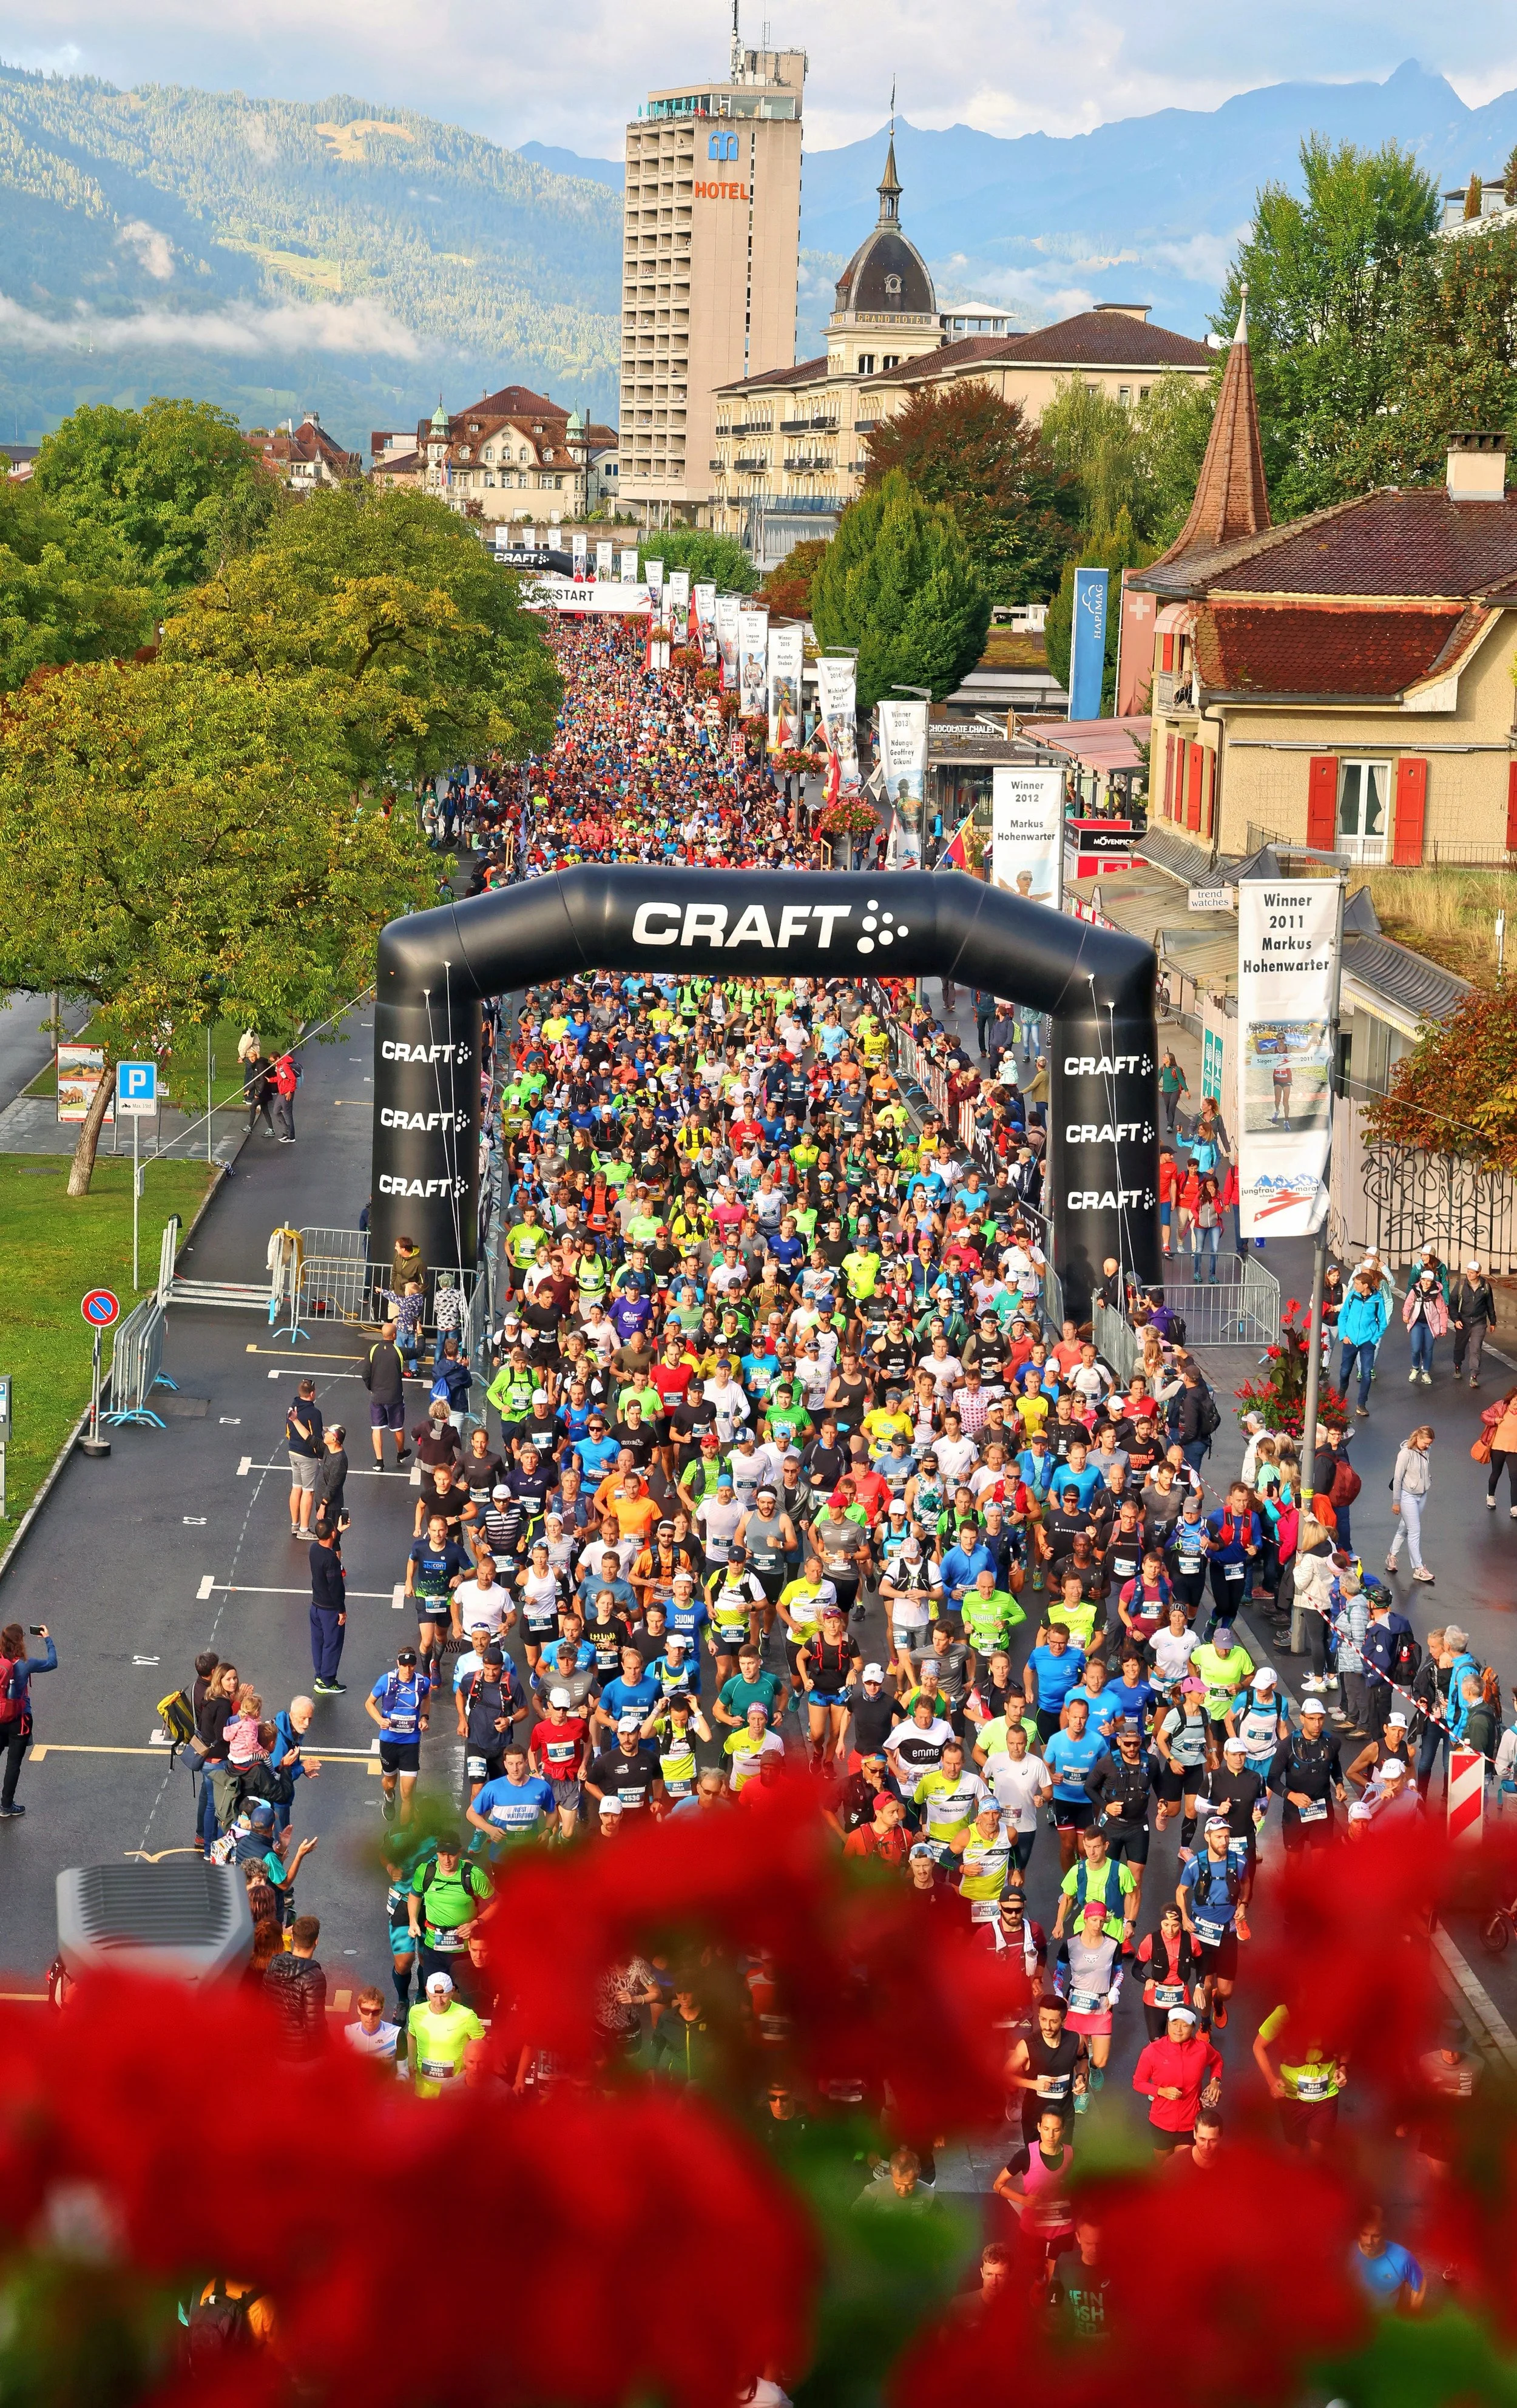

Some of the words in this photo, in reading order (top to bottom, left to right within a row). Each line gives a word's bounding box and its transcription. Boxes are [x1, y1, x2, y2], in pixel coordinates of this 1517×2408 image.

[695, 181, 749, 200] HOTEL
[858, 314, 890, 323] GRAND
[895, 315, 927, 324] HOTEL
[494, 553, 538, 563] CRAFT
[556, 589, 594, 601] START
[1094, 584, 1103, 639] HAPIMAG
[928, 724, 968, 734] CHOCOLATE
[1011, 781, 1044, 789] Winner
[1191, 898, 1229, 907] watches
[1264, 893, 1312, 907] Winner
[632, 902, 852, 948] CRAFT
[1269, 915, 1303, 928] 2011
[1262, 936, 1312, 950] Markus
[1244, 959, 1329, 973] Hohenwarter
[382, 1040, 456, 1063] CRAFT
[1064, 1056, 1140, 1076] CRAFT
[129, 1070, 146, 1095] P
[380, 1108, 453, 1131] CRAFT
[1066, 1123, 1141, 1143] CRAFT
[379, 1174, 453, 1197] CRAFT
[1242, 1187, 1274, 1196] jungfrau
[1067, 1190, 1143, 1210] CRAFT
[182, 1516, 208, 1525] 23
[675, 1614, 695, 1624] SUOMI
[132, 1655, 161, 1665] 24
[912, 1749, 939, 1758] emme
[1199, 1930, 1215, 1938] MAXIME
[1073, 2290, 1103, 2307] FIN
